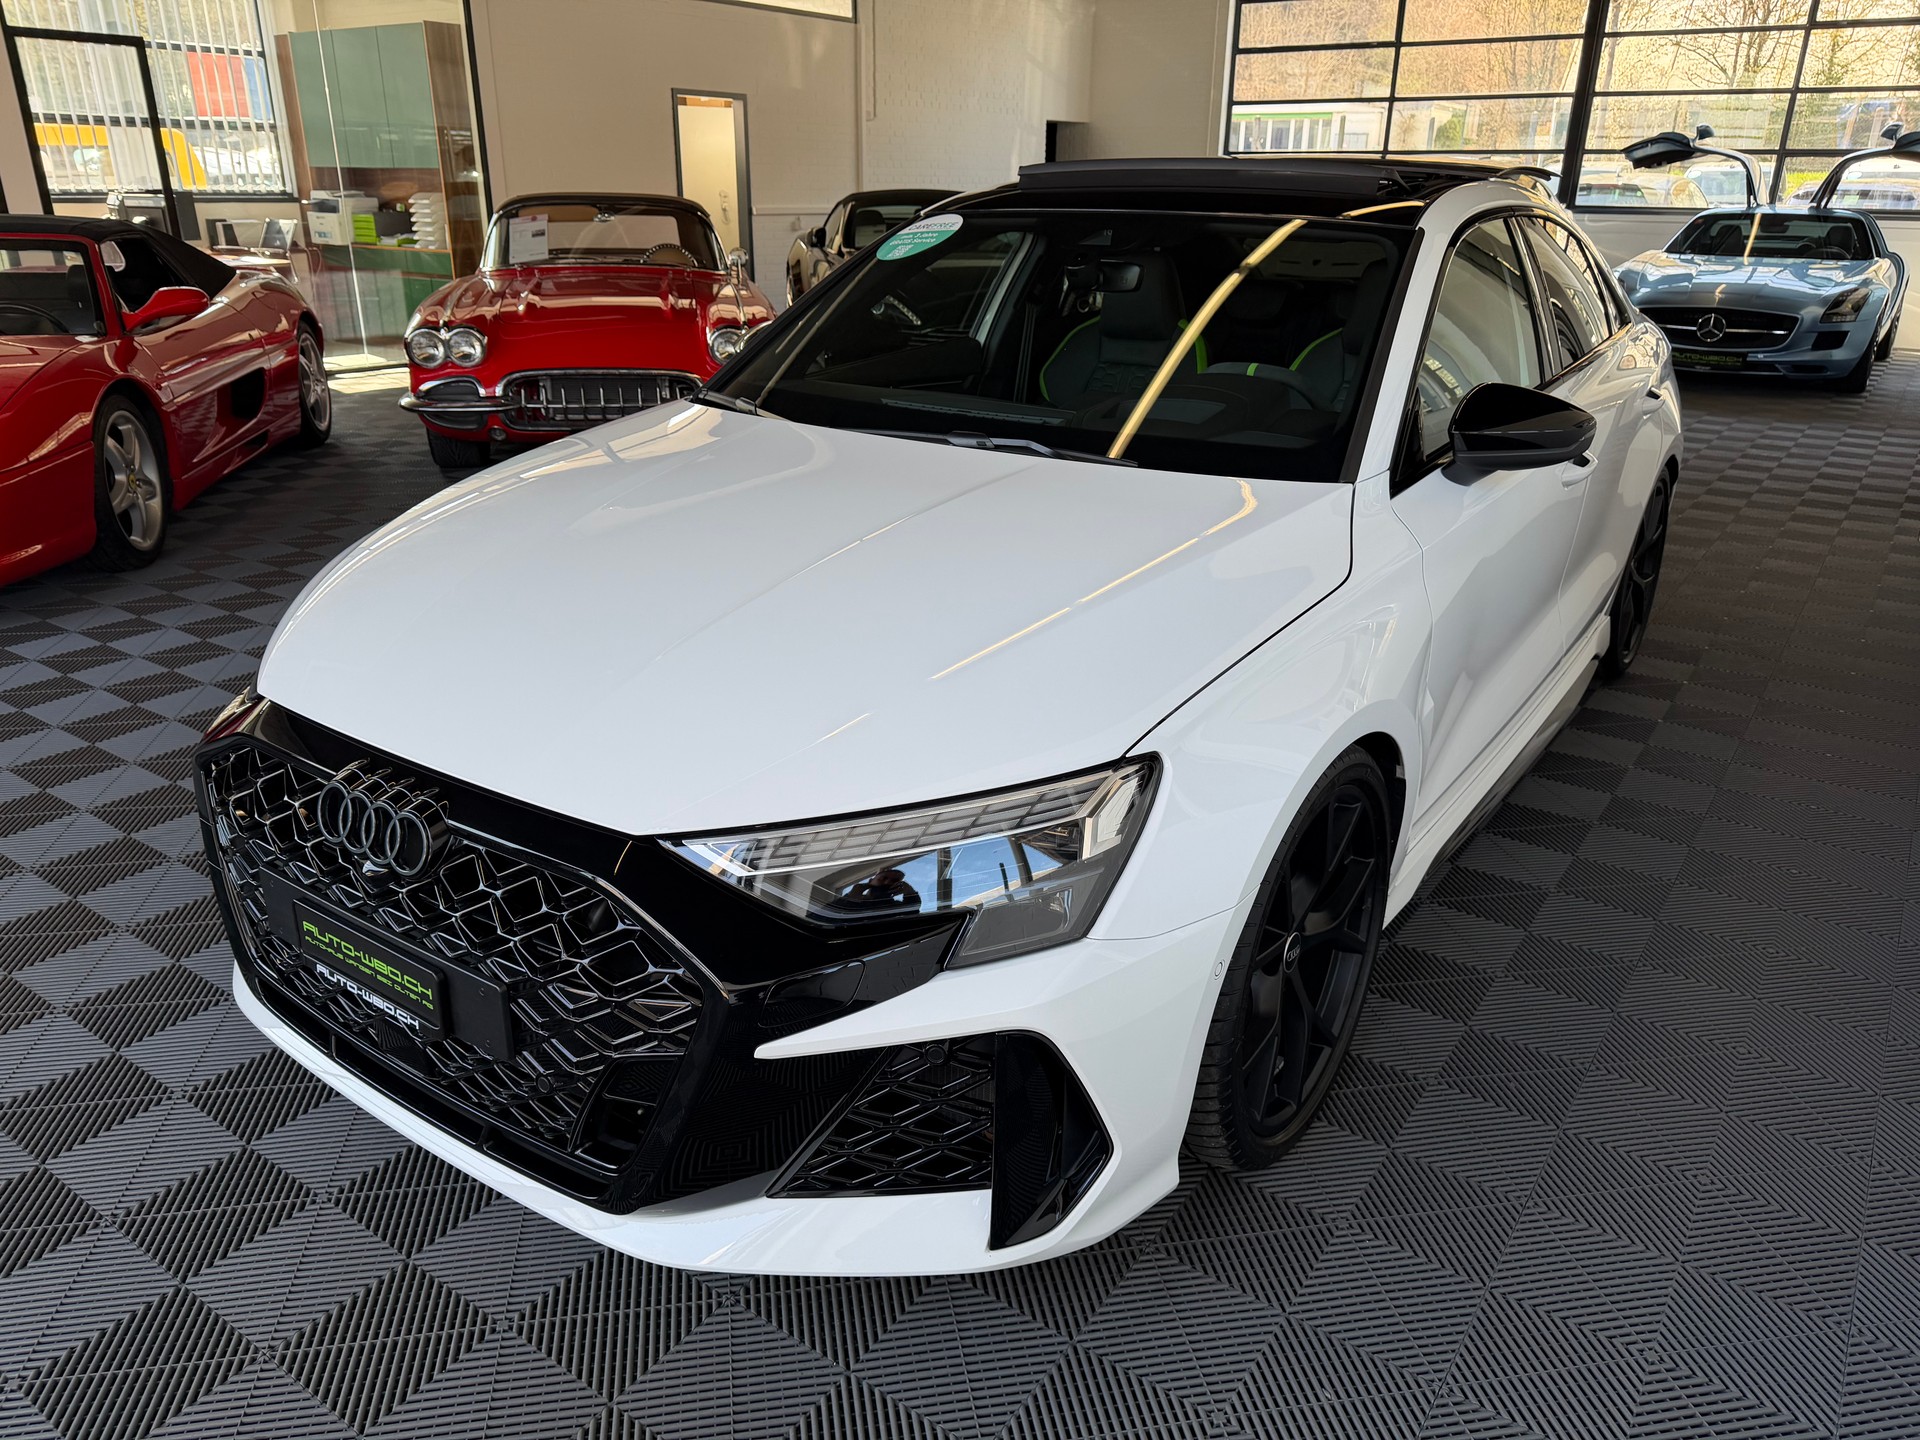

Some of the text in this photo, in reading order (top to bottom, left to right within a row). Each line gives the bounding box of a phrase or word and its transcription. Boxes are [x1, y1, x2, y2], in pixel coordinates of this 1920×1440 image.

[305, 936, 344, 960] AUTOHAUS
[345, 957, 375, 977] WANGEN
[394, 985, 421, 1003] OLTEN
